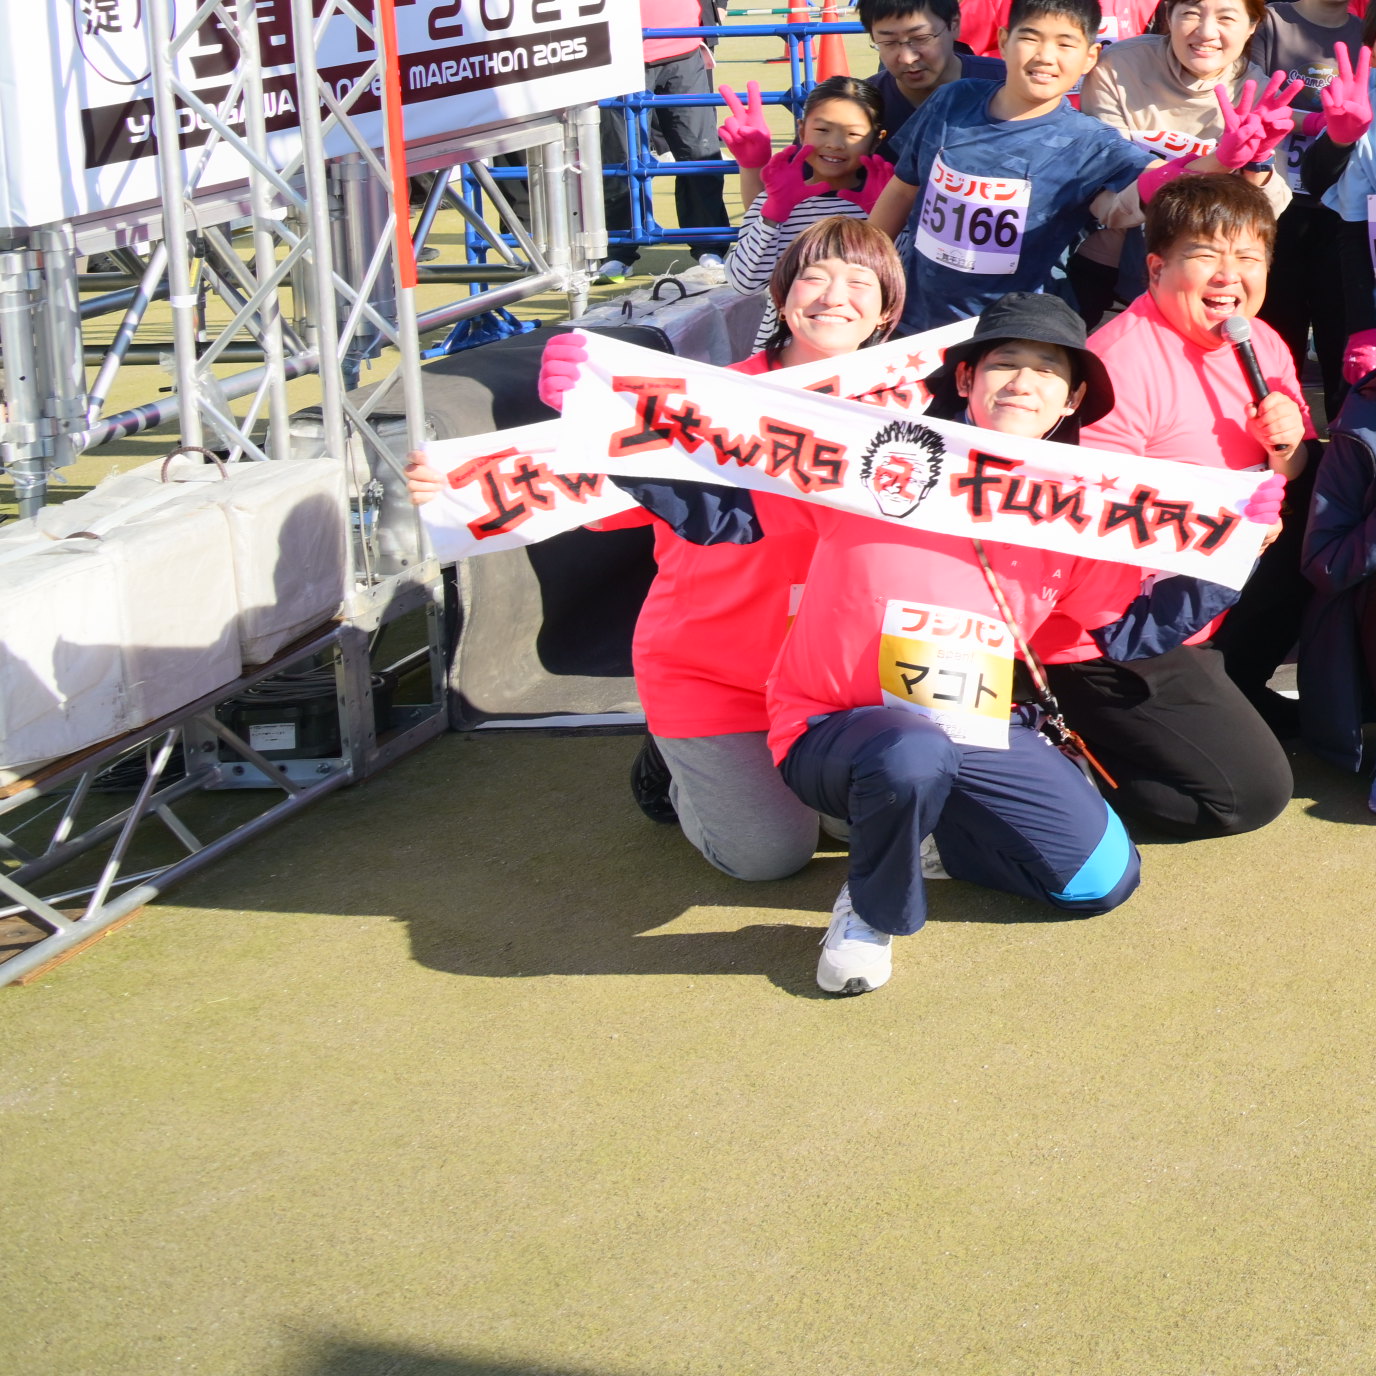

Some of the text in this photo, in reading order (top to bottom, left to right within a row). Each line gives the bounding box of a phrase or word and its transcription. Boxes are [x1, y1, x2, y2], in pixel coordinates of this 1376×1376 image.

[409, 47, 529, 92] MARATHON
[533, 36, 588, 67] 2025
[934, 163, 1018, 201] フジパン
[921, 192, 1020, 248] E5166
[1097, 483, 1243, 557] day
[901, 607, 1004, 649] フジパン
[894, 659, 999, 710] マコト
